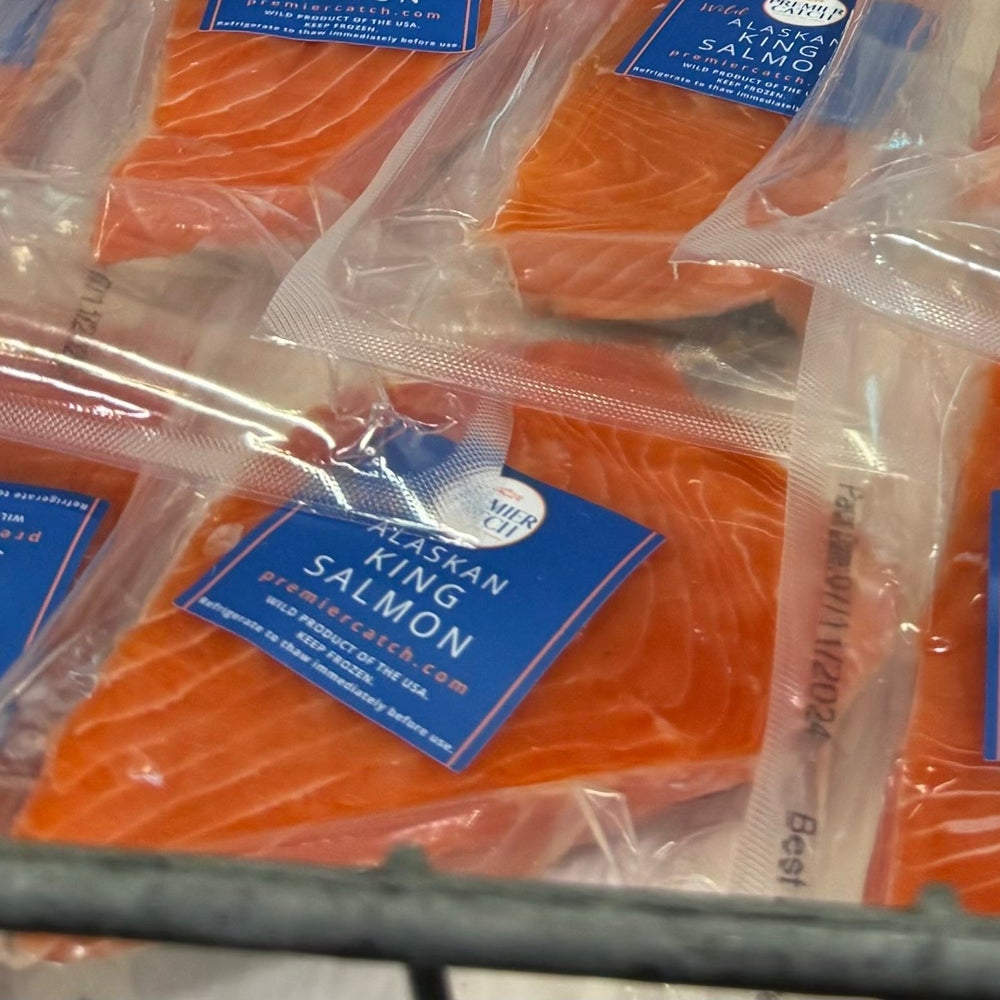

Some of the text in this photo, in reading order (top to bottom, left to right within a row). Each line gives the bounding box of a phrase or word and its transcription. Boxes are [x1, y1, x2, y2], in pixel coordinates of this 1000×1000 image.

[247, 0, 441, 19] premiercatch.com
[264, 10, 293, 18] WILD
[297, 14, 349, 22] PRODUCT
[396, 20, 420, 28] USA.
[700, 3, 749, 16] Wild
[771, 5, 835, 21] CATCH
[298, 30, 326, 38] thaw
[329, 31, 397, 44] immediately
[400, 37, 435, 46] before
[738, 31, 819, 58] KING
[633, 66, 690, 84] Refrigerate
[708, 83, 734, 95] thaw
[682, 61, 709, 73] WILD
[713, 68, 762, 86] PRODUCT
[783, 85, 803, 95] THE
[716, 78, 786, 100] KEEP FROZEN.
[14, 492, 88, 510] Refrigerate
[367, 522, 508, 595] ALASKAN
[364, 547, 466, 609] KING
[303, 555, 474, 658] SALMON
[258, 571, 468, 695] premiercatch.com
[265, 594, 428, 700] WILD PRODUCT OF THE USA.
[296, 632, 375, 686] KEEP FROZEN.
[198, 597, 454, 754] Refrigerate to thaw immediately before use.
[779, 812, 817, 888] Best
